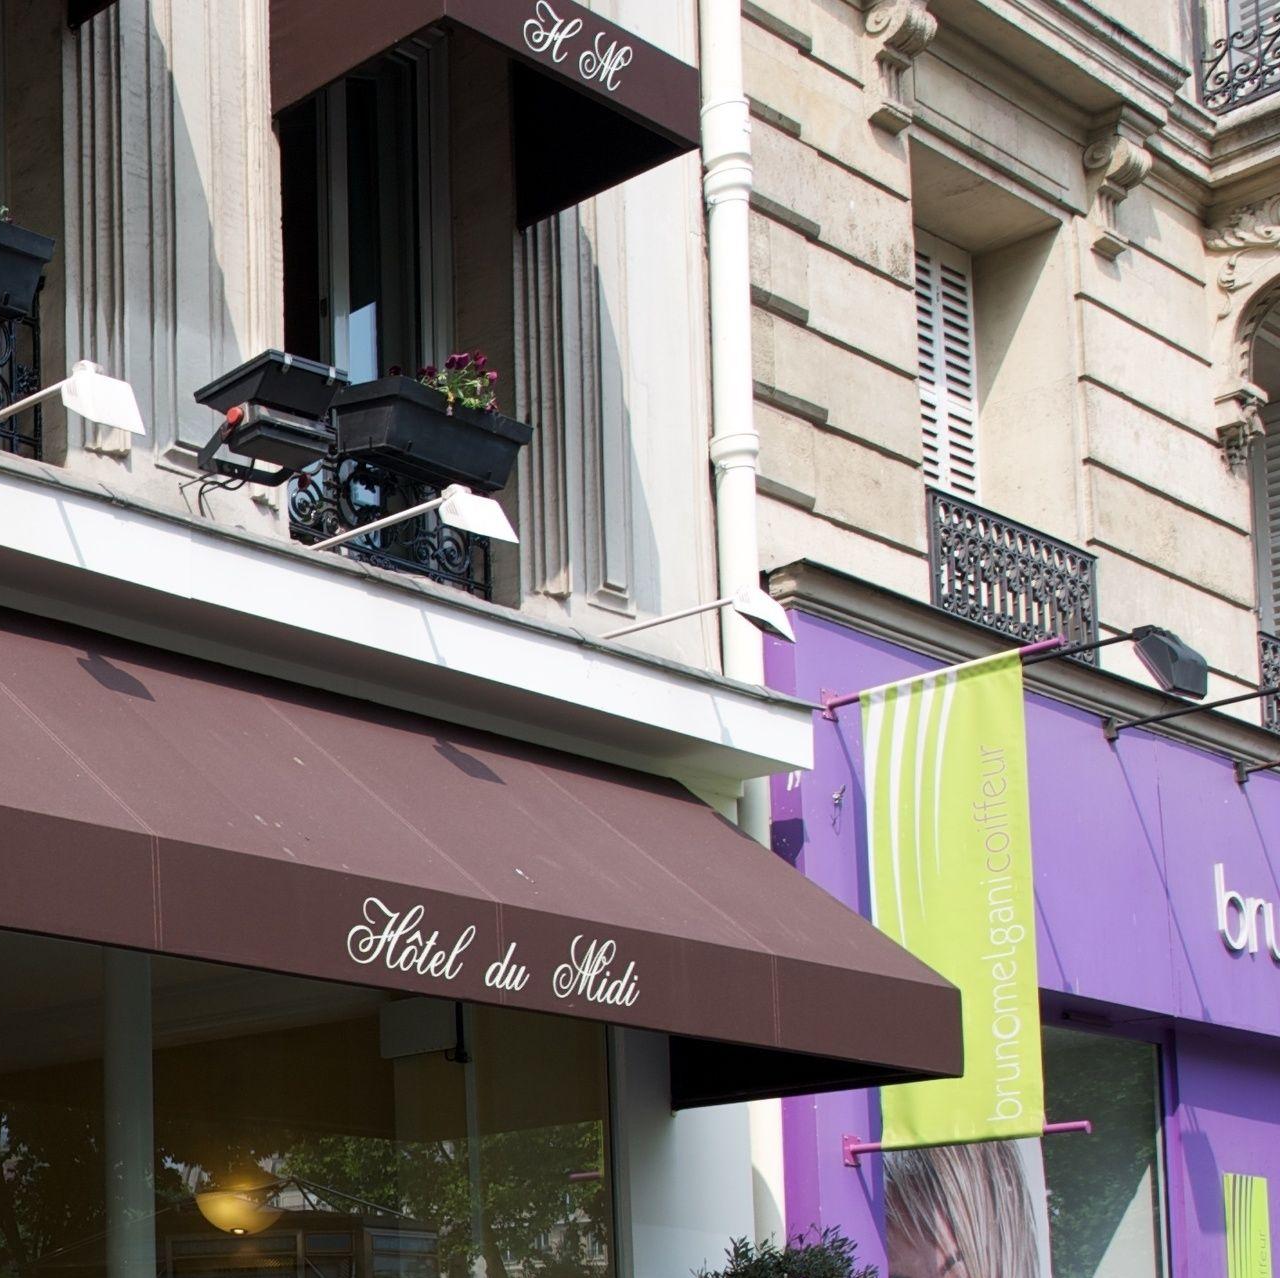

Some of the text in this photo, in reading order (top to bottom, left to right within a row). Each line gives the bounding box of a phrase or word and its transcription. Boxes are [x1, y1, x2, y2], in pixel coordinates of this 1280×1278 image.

[523, 0, 633, 92] H M
[346, 896, 641, 1007] Hôtel du Midi
